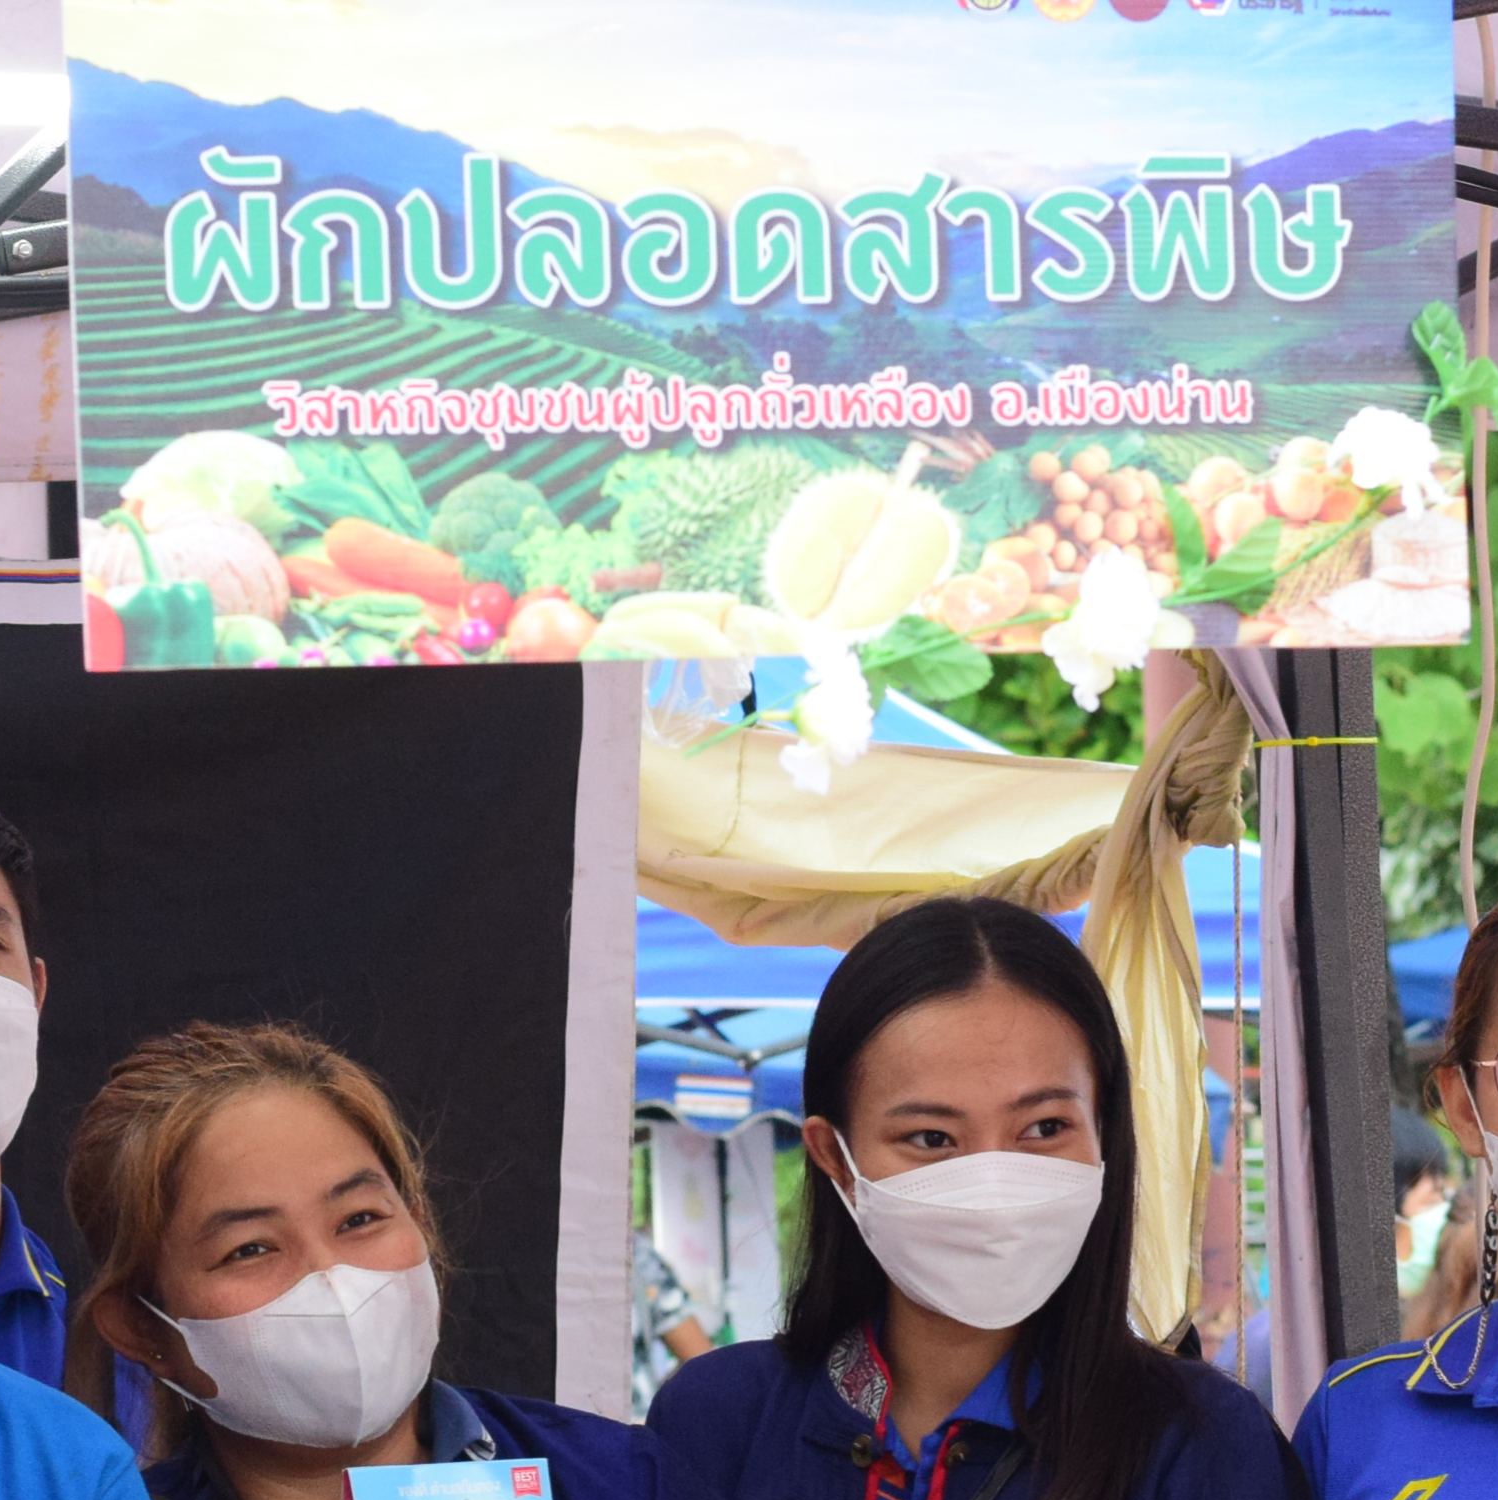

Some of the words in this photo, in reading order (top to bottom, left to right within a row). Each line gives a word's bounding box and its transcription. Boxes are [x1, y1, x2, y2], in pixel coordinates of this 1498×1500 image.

[164, 145, 1351, 309] ผักปลอดสารพิษ
[262, 351, 972, 450] วิสาหกิจชุมชนผู้ปลูกถั่วเหลือง
[991, 363, 1253, 426] อ.เมืองน่าน
[514, 1471, 537, 1482] BEST
